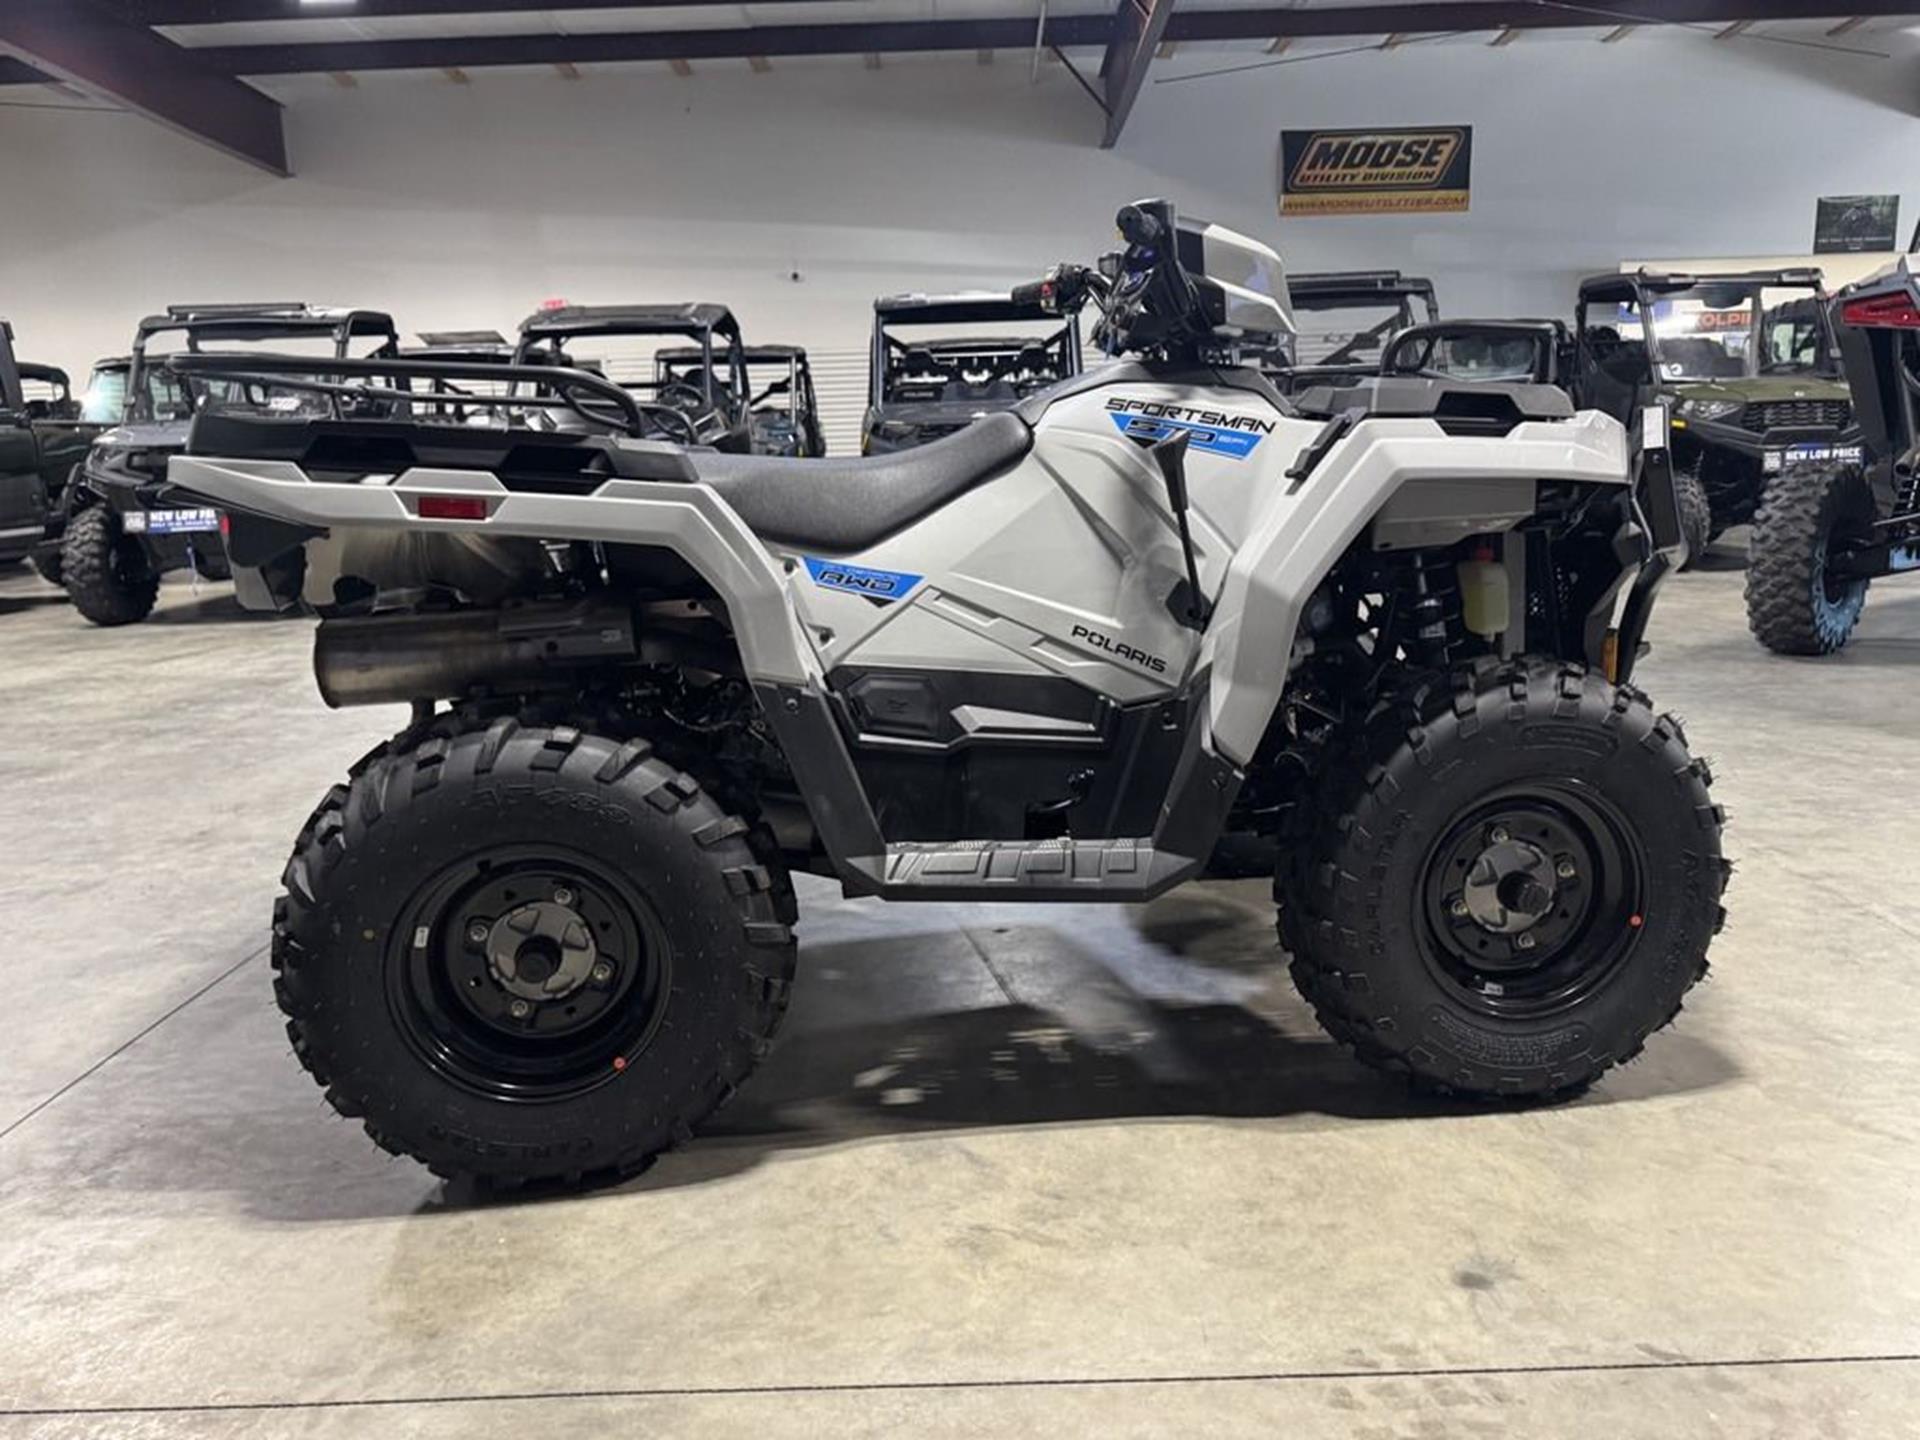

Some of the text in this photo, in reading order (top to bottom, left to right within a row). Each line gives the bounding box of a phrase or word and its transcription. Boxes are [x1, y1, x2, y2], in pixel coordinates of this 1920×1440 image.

[1306, 139, 1450, 170] MOOSE
[1300, 169, 1435, 184] UTILITY DIVISION
[1105, 398, 1276, 434] SPORTSMAN
[1786, 447, 1861, 460] NEW LOW PRICE
[817, 569, 898, 593] AWD
[1071, 624, 1167, 673] POLARIS
